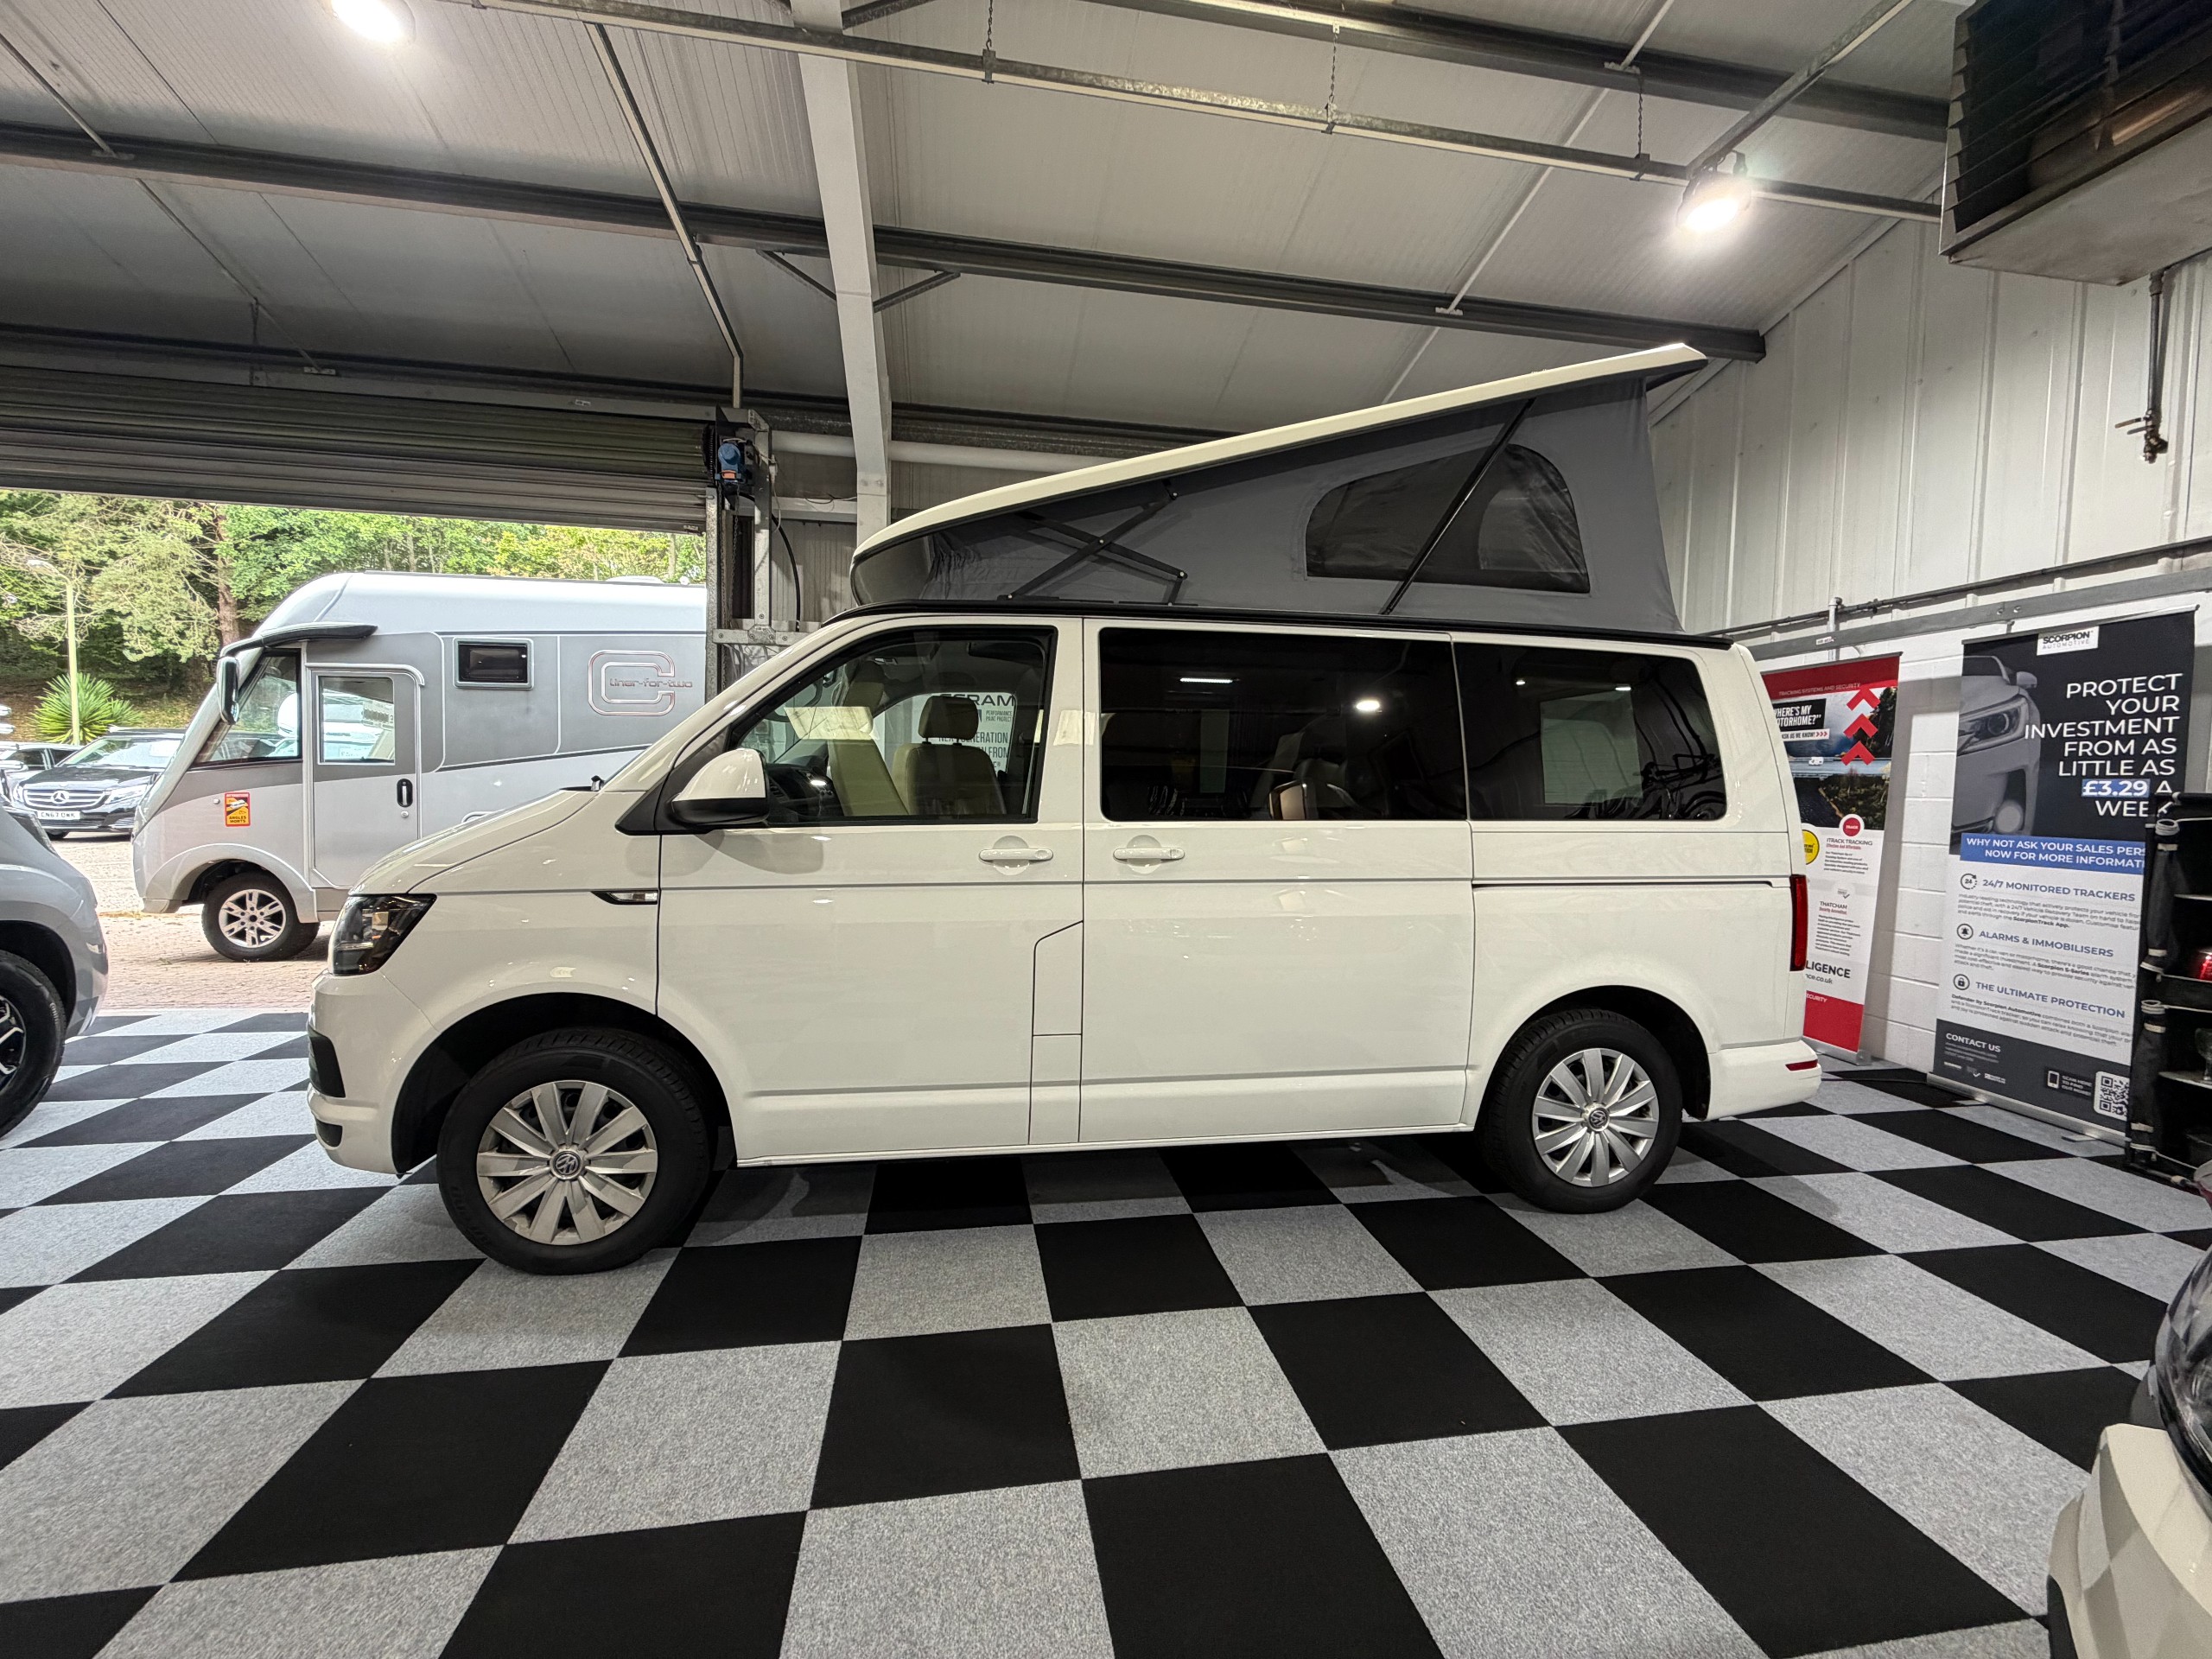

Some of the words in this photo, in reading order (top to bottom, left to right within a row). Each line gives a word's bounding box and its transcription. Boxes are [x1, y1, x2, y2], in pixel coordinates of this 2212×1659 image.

[2043, 632, 2090, 645] SCORPION
[2043, 639, 2089, 649] AUTOMOTIVE
[2066, 673, 2183, 698] PROTECT
[1801, 705, 1812, 715] MY
[2106, 696, 2180, 715] YOUR
[2024, 715, 2180, 740] INVESTMENT
[2064, 739, 2135, 757] FROM
[2141, 738, 2177, 755] AS
[2058, 760, 2134, 777] LITTLE
[2140, 759, 2176, 776] AS
[2082, 779, 2148, 797] £3.29
[2155, 780, 2173, 794] A
[1967, 837, 1991, 848] WHY
[1993, 839, 2015, 849] NOT
[2016, 840, 2038, 850] ASK
[2040, 842, 2074, 852] YOUR
[2075, 843, 2114, 855] SALES
[1985, 849, 2012, 859] NOW
[2013, 851, 2036, 861] FOR
[2038, 853, 2073, 863] MORE
[1982, 879, 2004, 888] 24/7
[2005, 880, 2070, 895] MONITORED
[2073, 887, 2135, 902] TRACKERS
[1979, 930, 2020, 944] ALARMS
[2022, 936, 2030, 944] &
[2031, 938, 2113, 957] IMMOBILISERS
[1975, 981, 1995, 992] THE
[1997, 985, 2048, 1002] ULTIMATE
[2050, 996, 2125, 1019] PROTECTION
[1946, 1033, 1987, 1048] CONTACT
[1988, 1044, 2001, 1052] US
